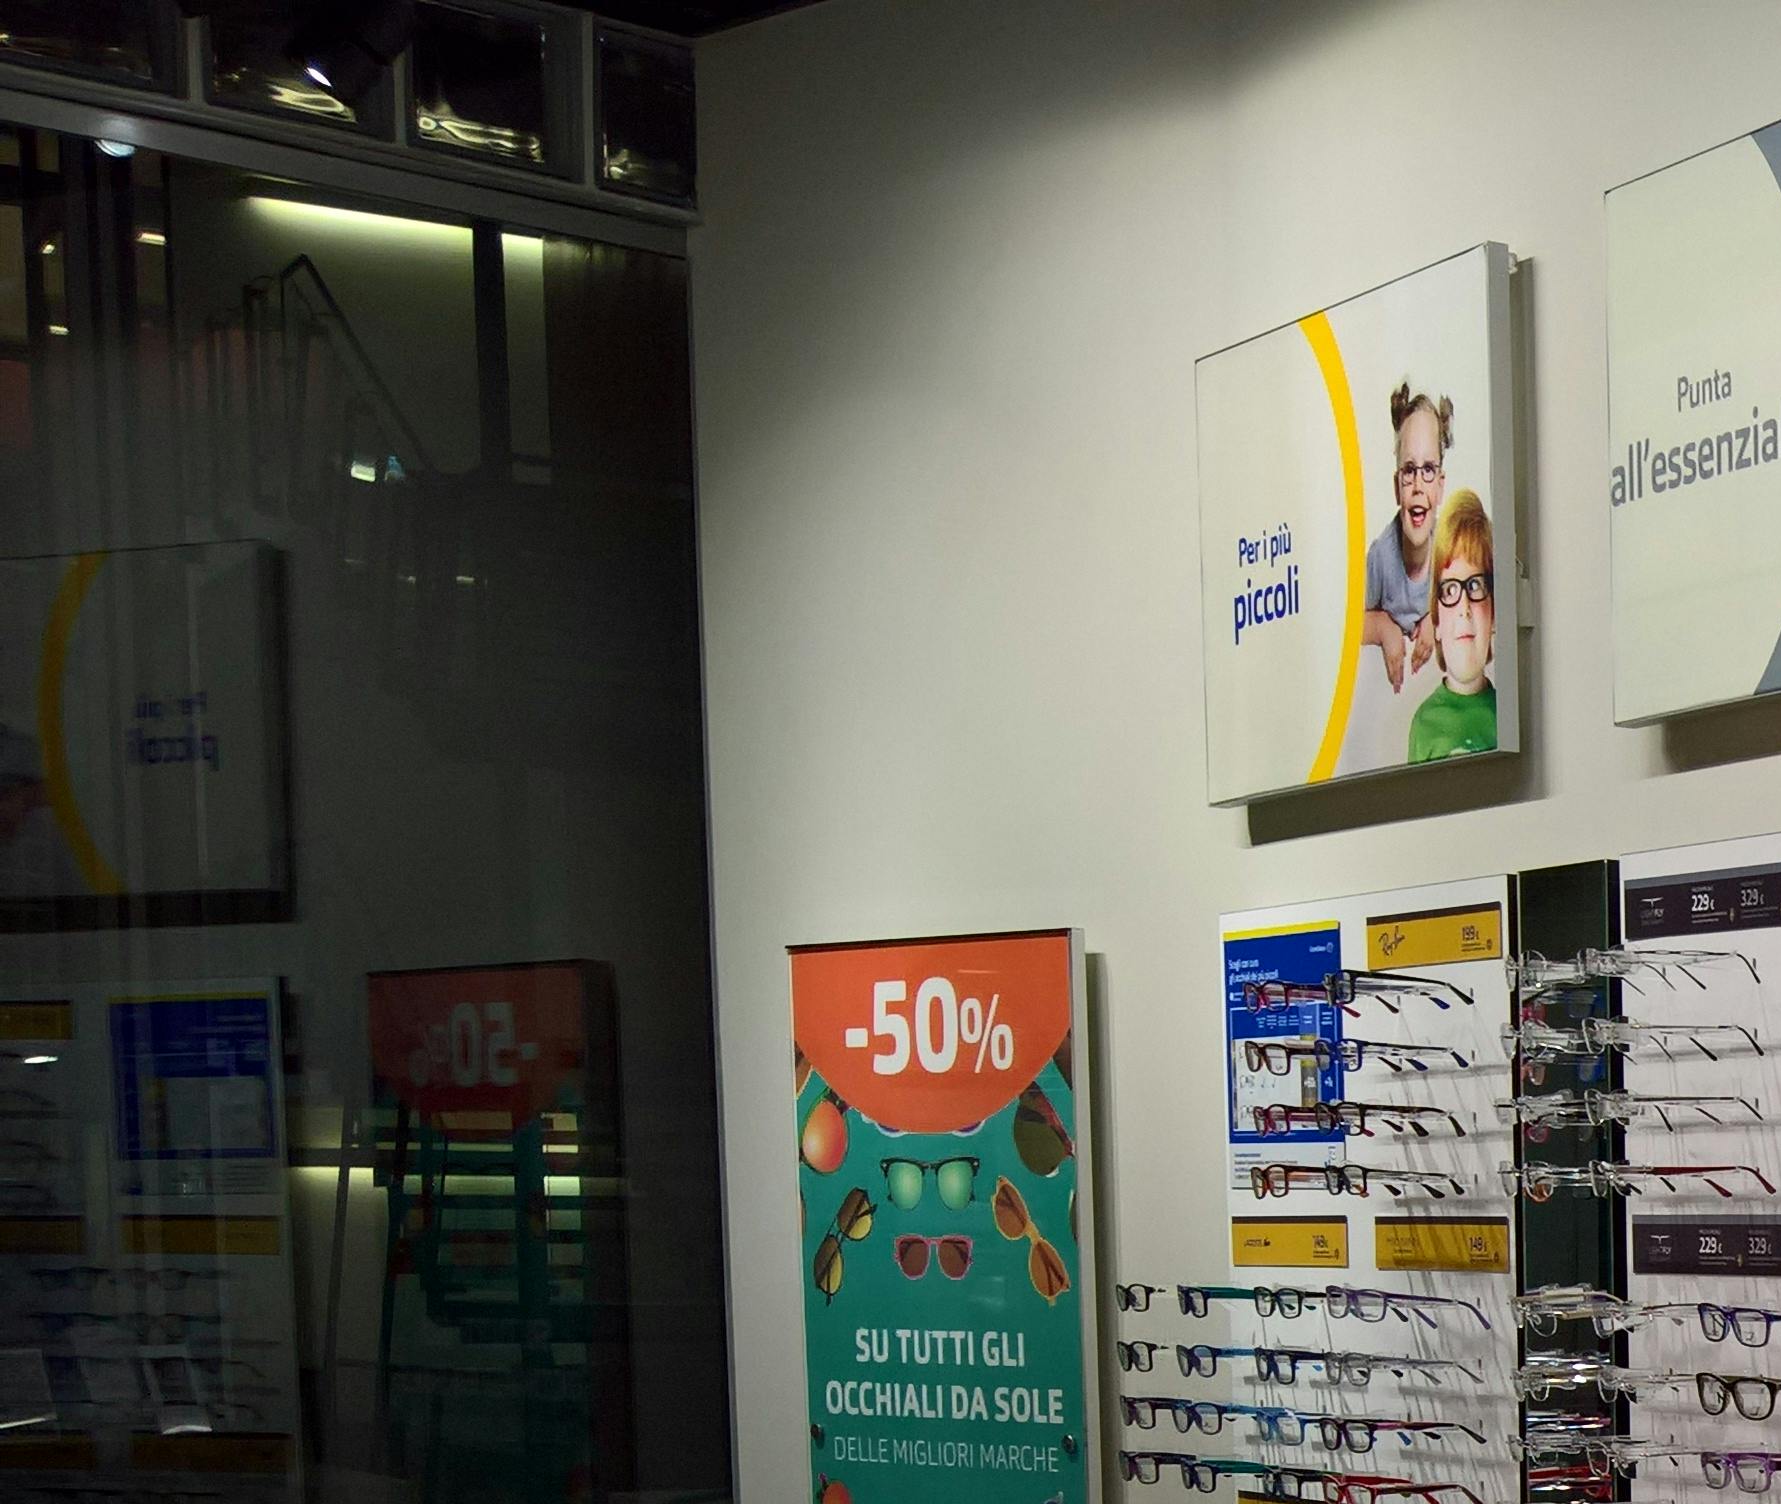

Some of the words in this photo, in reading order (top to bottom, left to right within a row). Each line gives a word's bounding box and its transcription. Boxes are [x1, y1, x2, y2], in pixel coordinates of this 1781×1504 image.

[1677, 369, 1732, 412] Punta
[1239, 538, 1260, 567] Per
[1263, 530, 1267, 560] i
[1271, 522, 1291, 567] più
[1234, 565, 1298, 645] piccoli
[845, 976, 1014, 1075] -50%
[856, 1328, 889, 1363] SU
[896, 1329, 975, 1366] TUTTI
[982, 1331, 1025, 1367] GLI
[826, 1380, 943, 1418] OCCHIALI
[951, 1385, 989, 1421] DA
[994, 1387, 1064, 1424] SOLE
[834, 1436, 889, 1463] DELLE
[893, 1439, 974, 1468] MIGLIORI
[980, 1443, 1059, 1473] MARCHE
